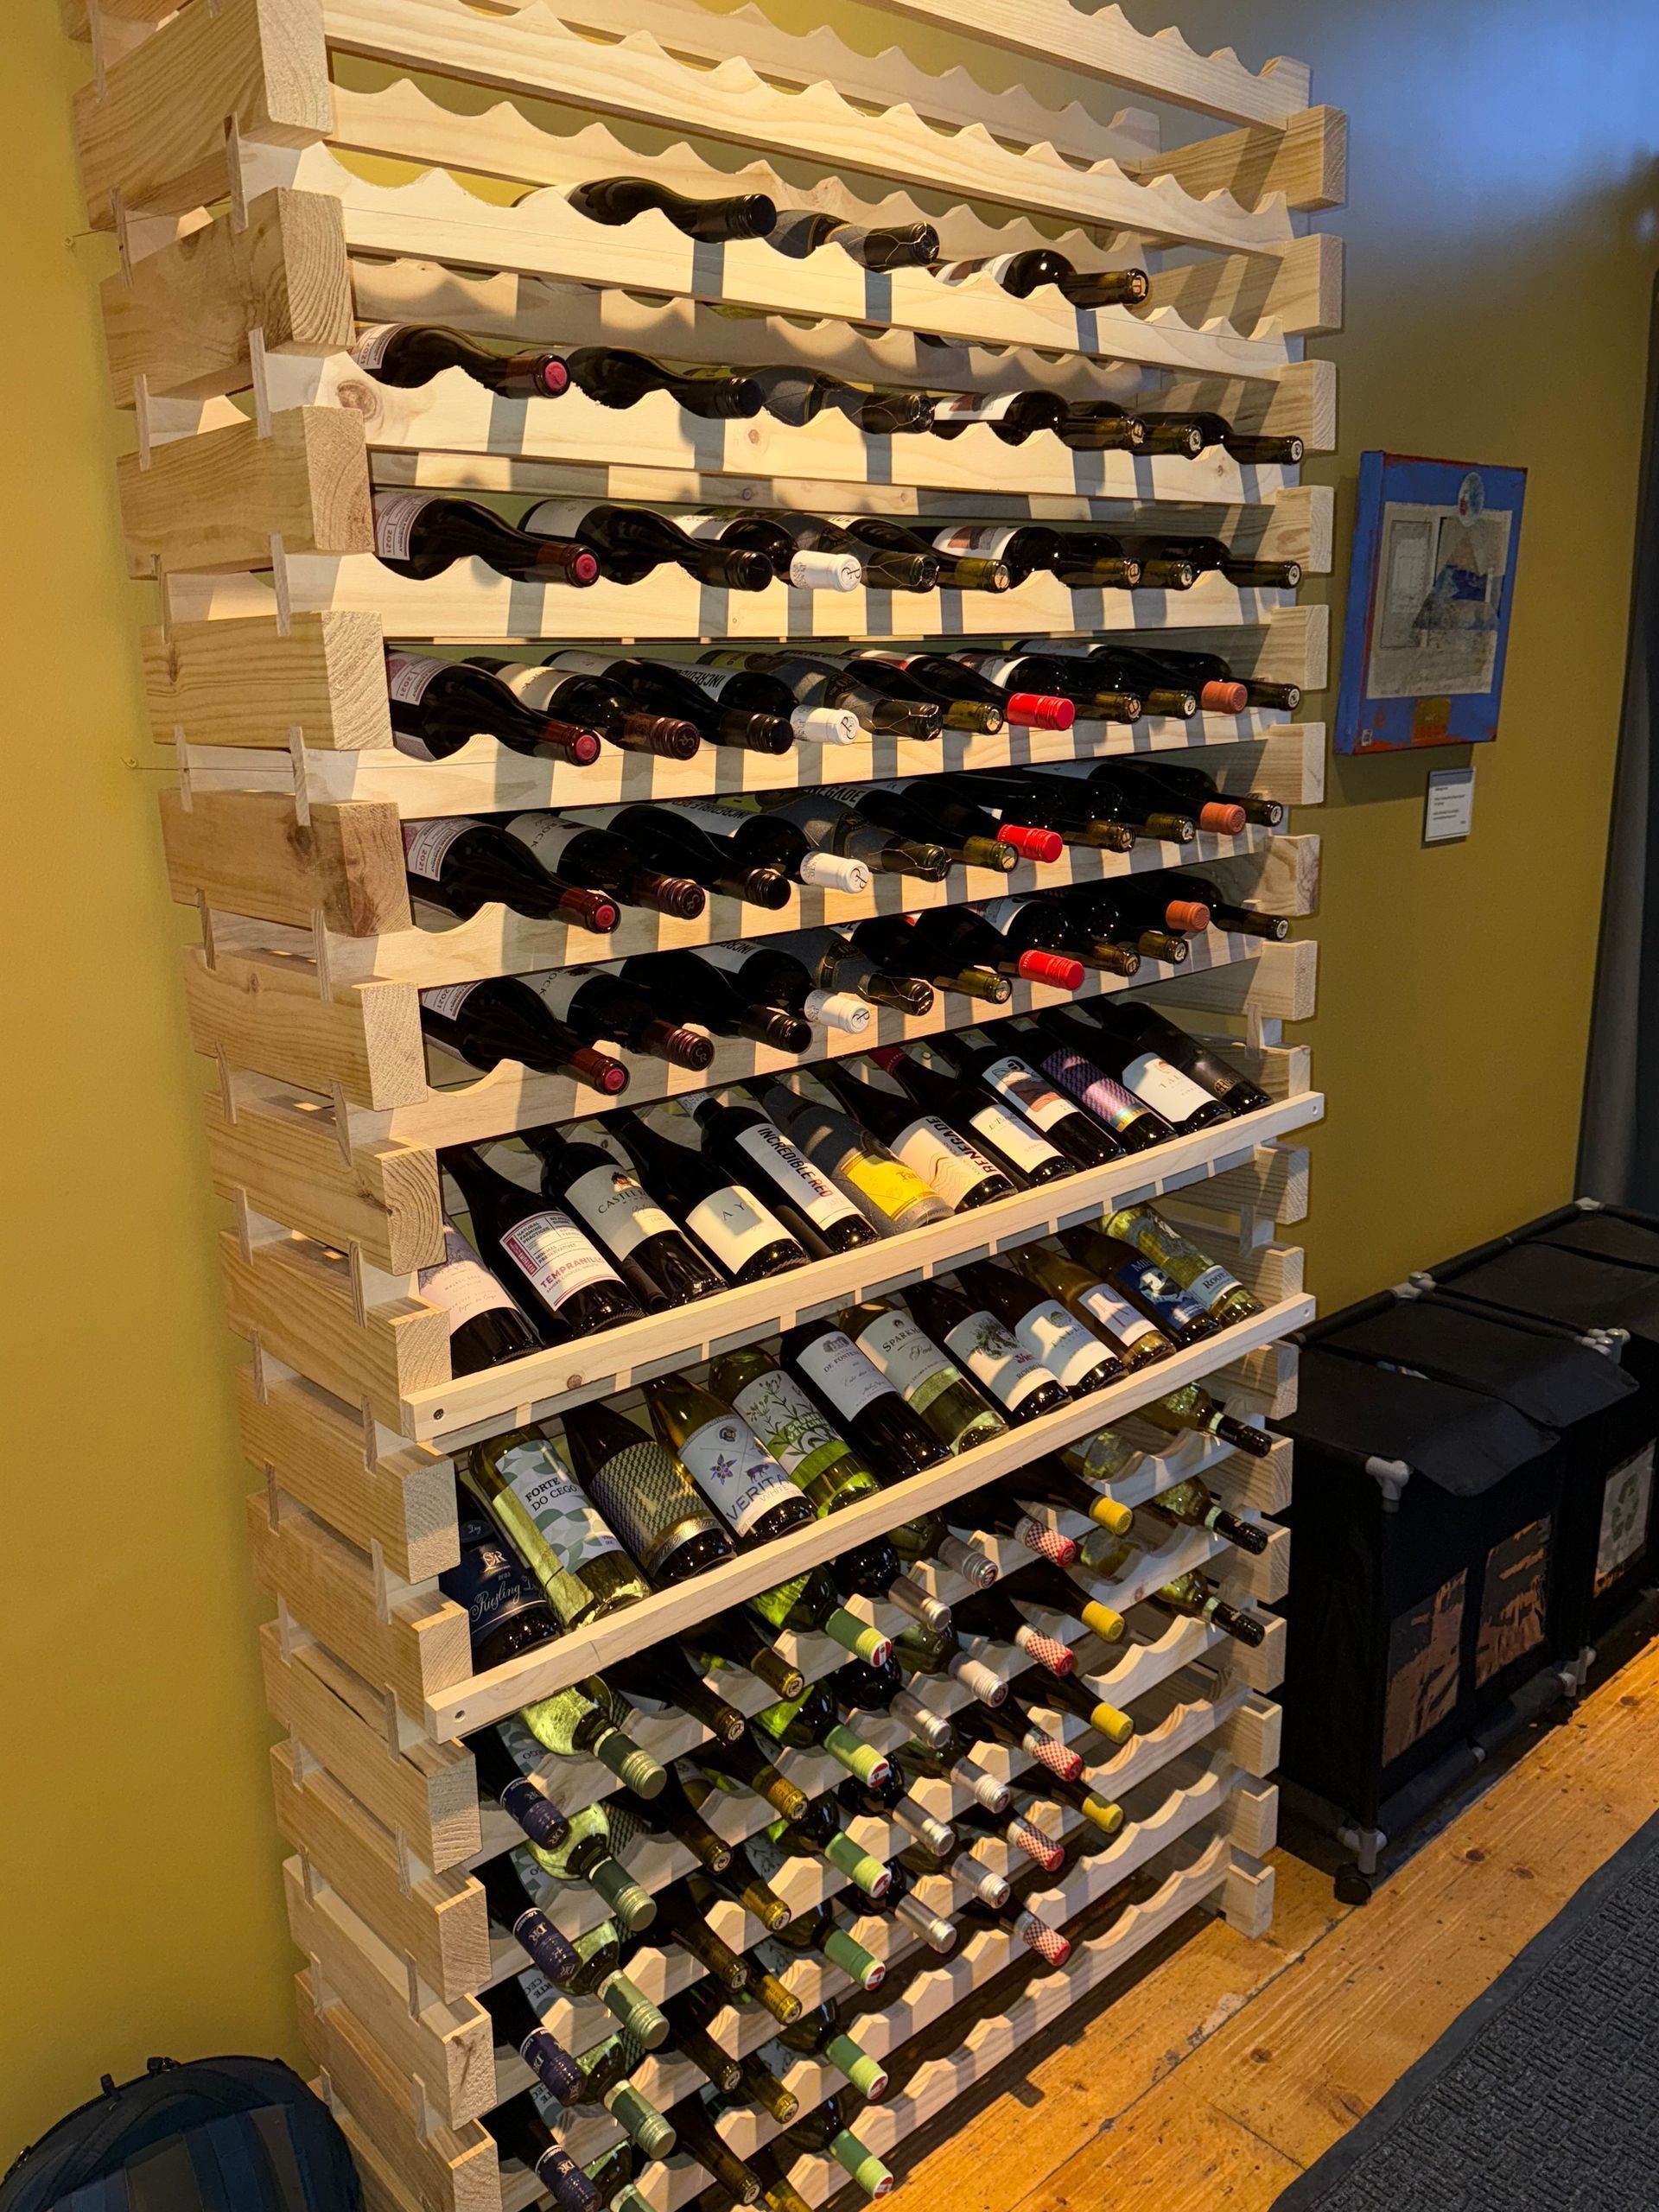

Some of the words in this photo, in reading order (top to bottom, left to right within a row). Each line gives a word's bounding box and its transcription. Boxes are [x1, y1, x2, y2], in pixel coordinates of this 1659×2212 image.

[385, 529, 394, 553] 2021
[399, 674, 414, 696] 2021
[418, 849, 428, 872] 2021
[436, 988, 450, 1010] 2021
[925, 1116, 997, 1174] RENEGADE
[757, 1127, 816, 1180] INCREDIBLE
[808, 1178, 835, 1198] RED
[517, 1221, 540, 1236] NATURAL
[519, 1224, 543, 1241] FARMING
[523, 1226, 551, 1244] PRACTICES
[823, 1362, 834, 1374] DE
[524, 1476, 562, 1503] FORTE
[530, 1496, 549, 1512] DO
[551, 1484, 578, 1499] CEGO
[725, 1473, 790, 1521] VERITA
[759, 1484, 790, 1503] WHITE
[467, 1523, 482, 1535] Dry
[468, 1580, 522, 1623] Riesling
